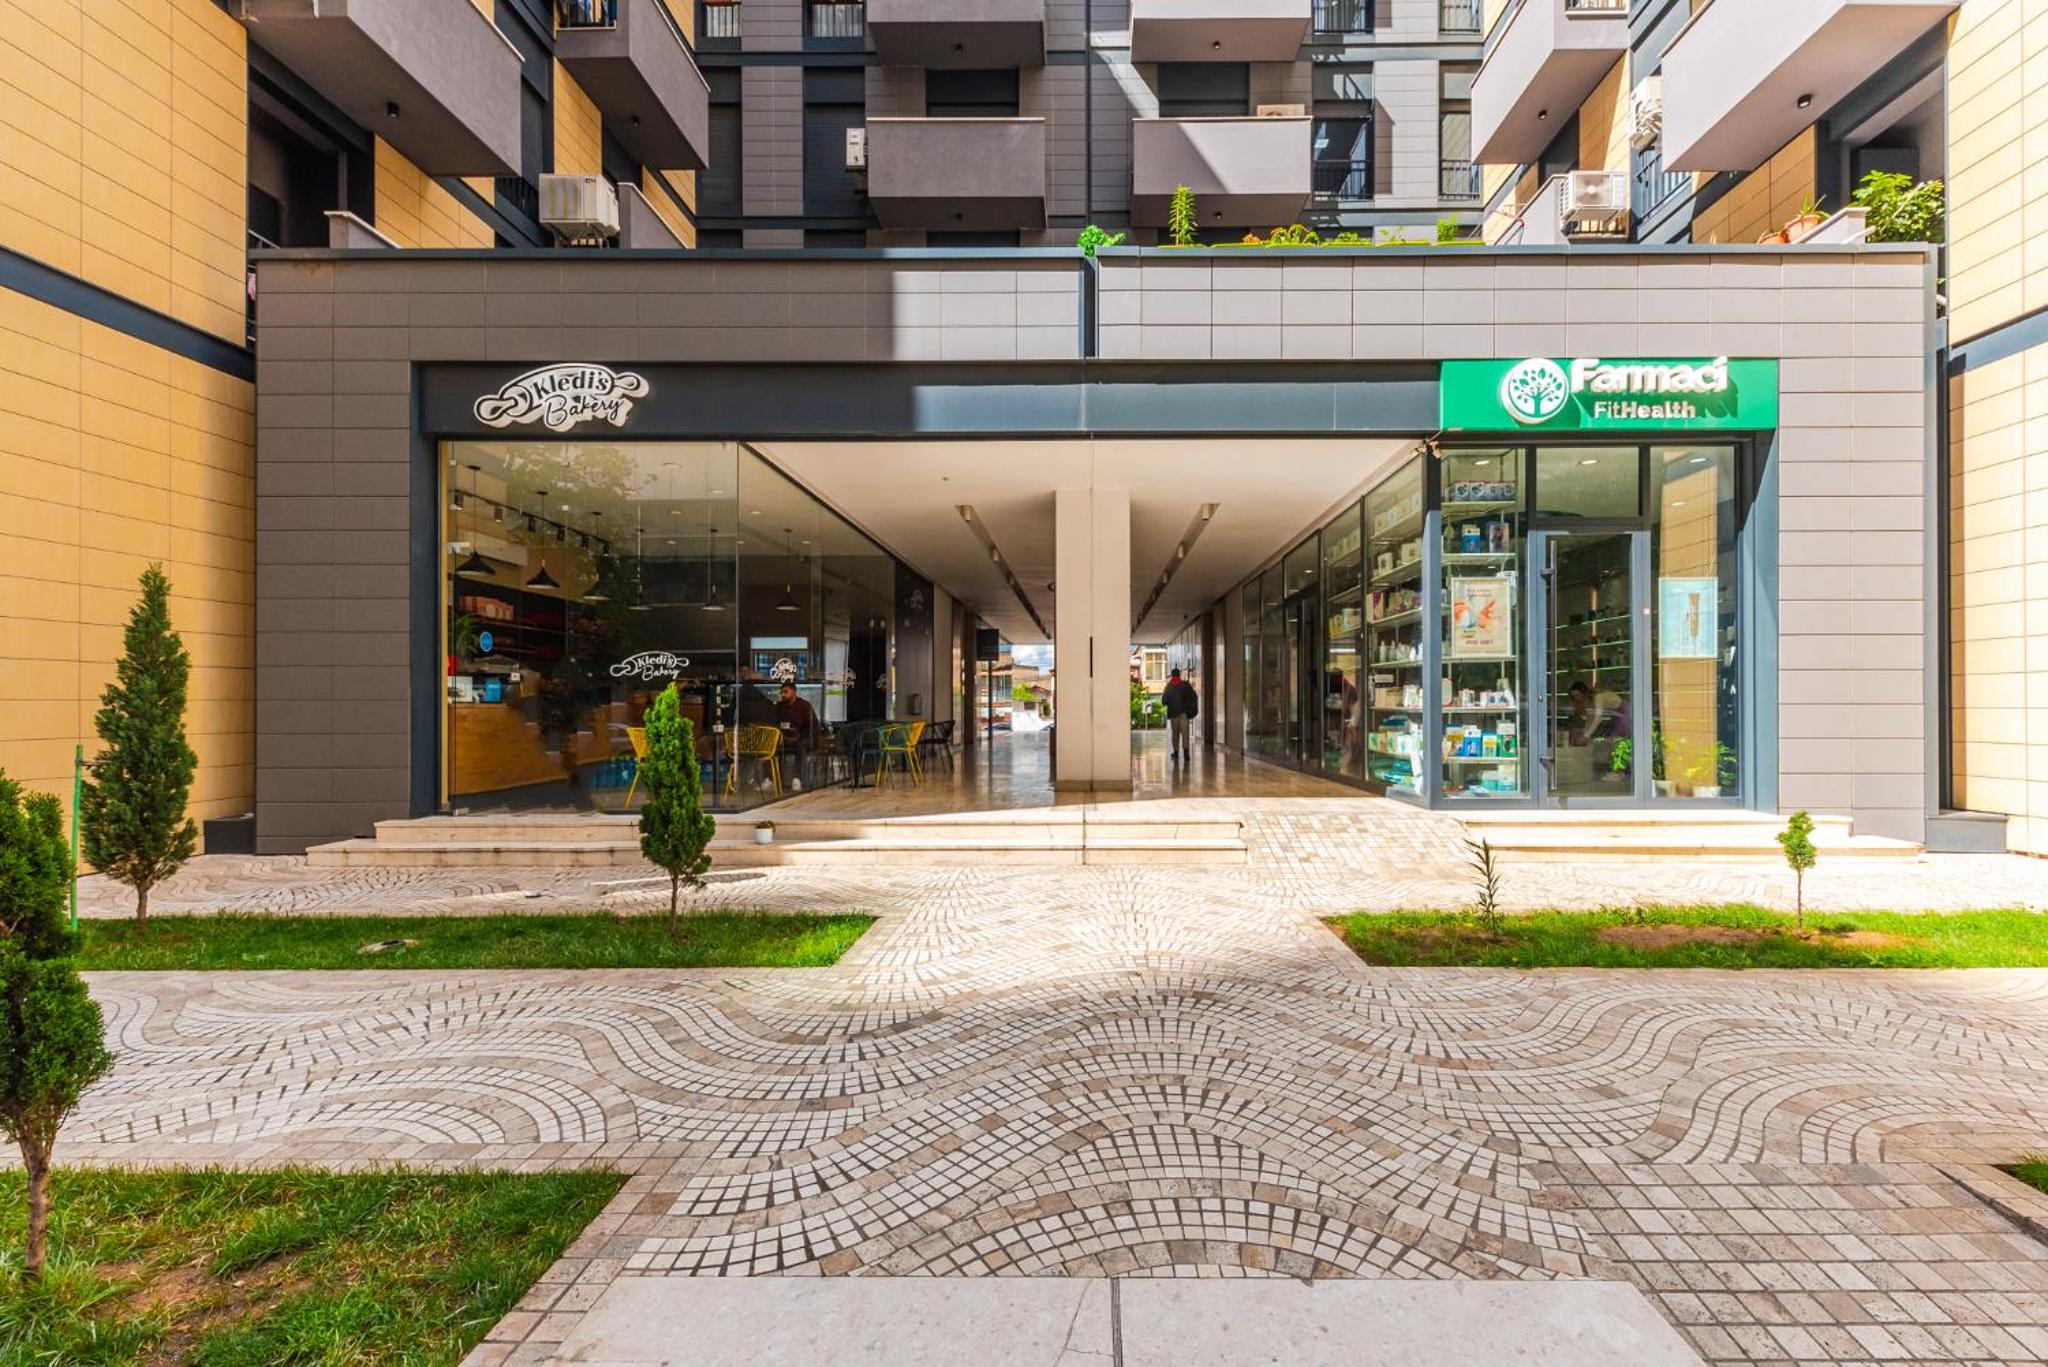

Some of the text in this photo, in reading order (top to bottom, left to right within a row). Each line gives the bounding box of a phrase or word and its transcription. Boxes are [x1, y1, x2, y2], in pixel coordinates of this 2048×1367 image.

[532, 371, 609, 400] Kledi's
[1570, 355, 1728, 393] Farmaci
[545, 395, 624, 426] Bakery
[1594, 400, 1696, 419] FitHealth
[642, 665, 680, 680] Bakery
